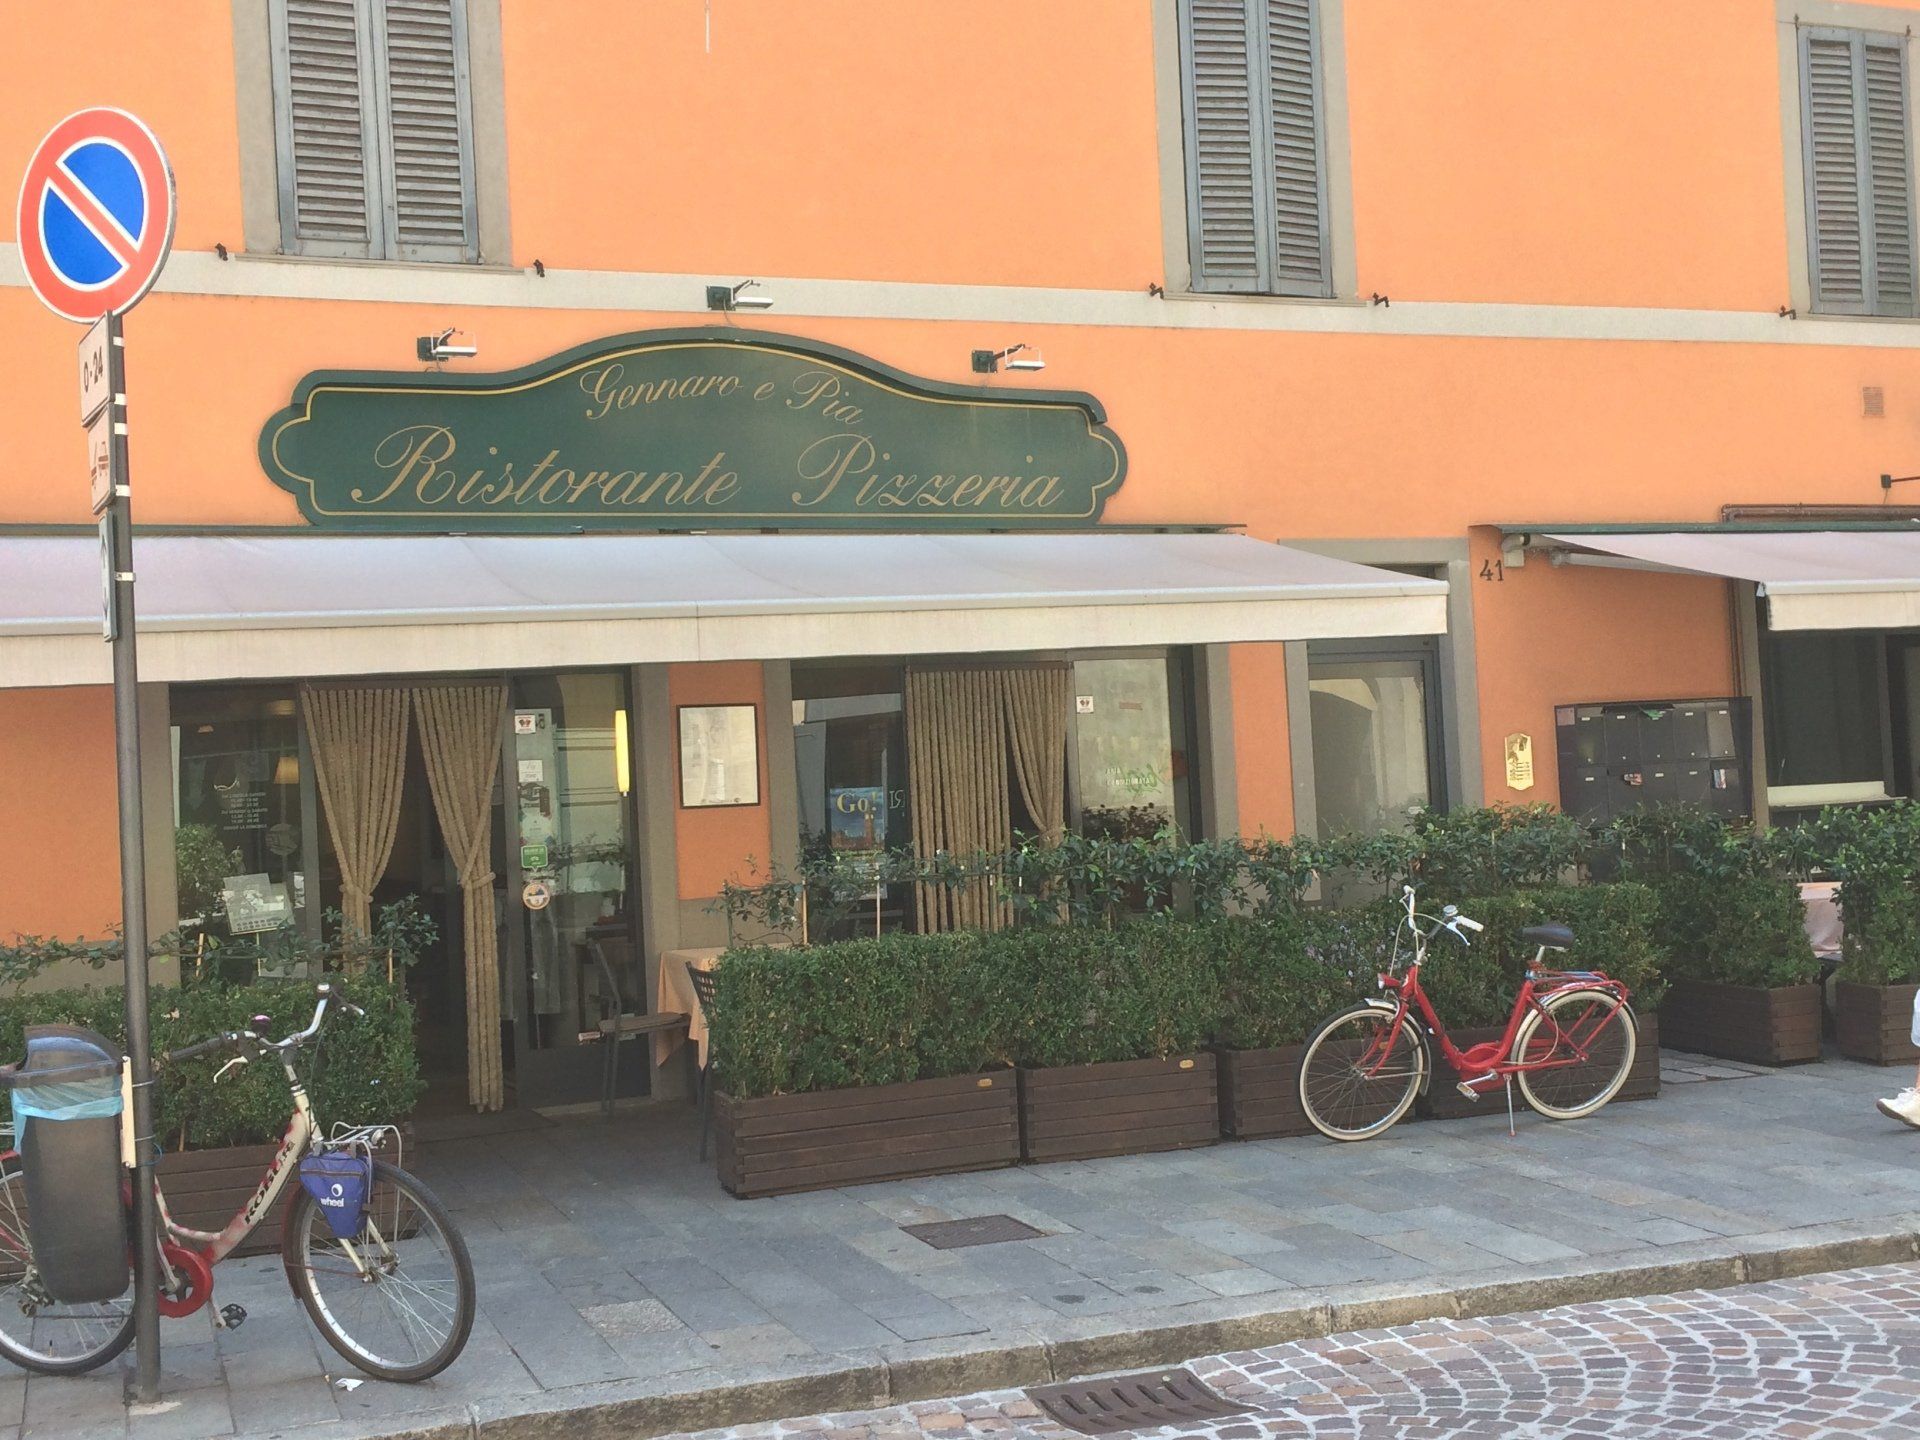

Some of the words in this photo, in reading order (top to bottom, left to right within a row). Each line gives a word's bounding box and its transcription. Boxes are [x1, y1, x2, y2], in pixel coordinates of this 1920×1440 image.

[580, 363, 743, 420] Gennaro
[753, 381, 775, 401] e
[785, 371, 864, 425] Pia
[350, 424, 743, 506] Ristorante
[792, 433, 1065, 507] Pizzeria
[1479, 559, 1504, 581] 41
[836, 791, 878, 814] Go!
[320, 1196, 345, 1208] wheel
